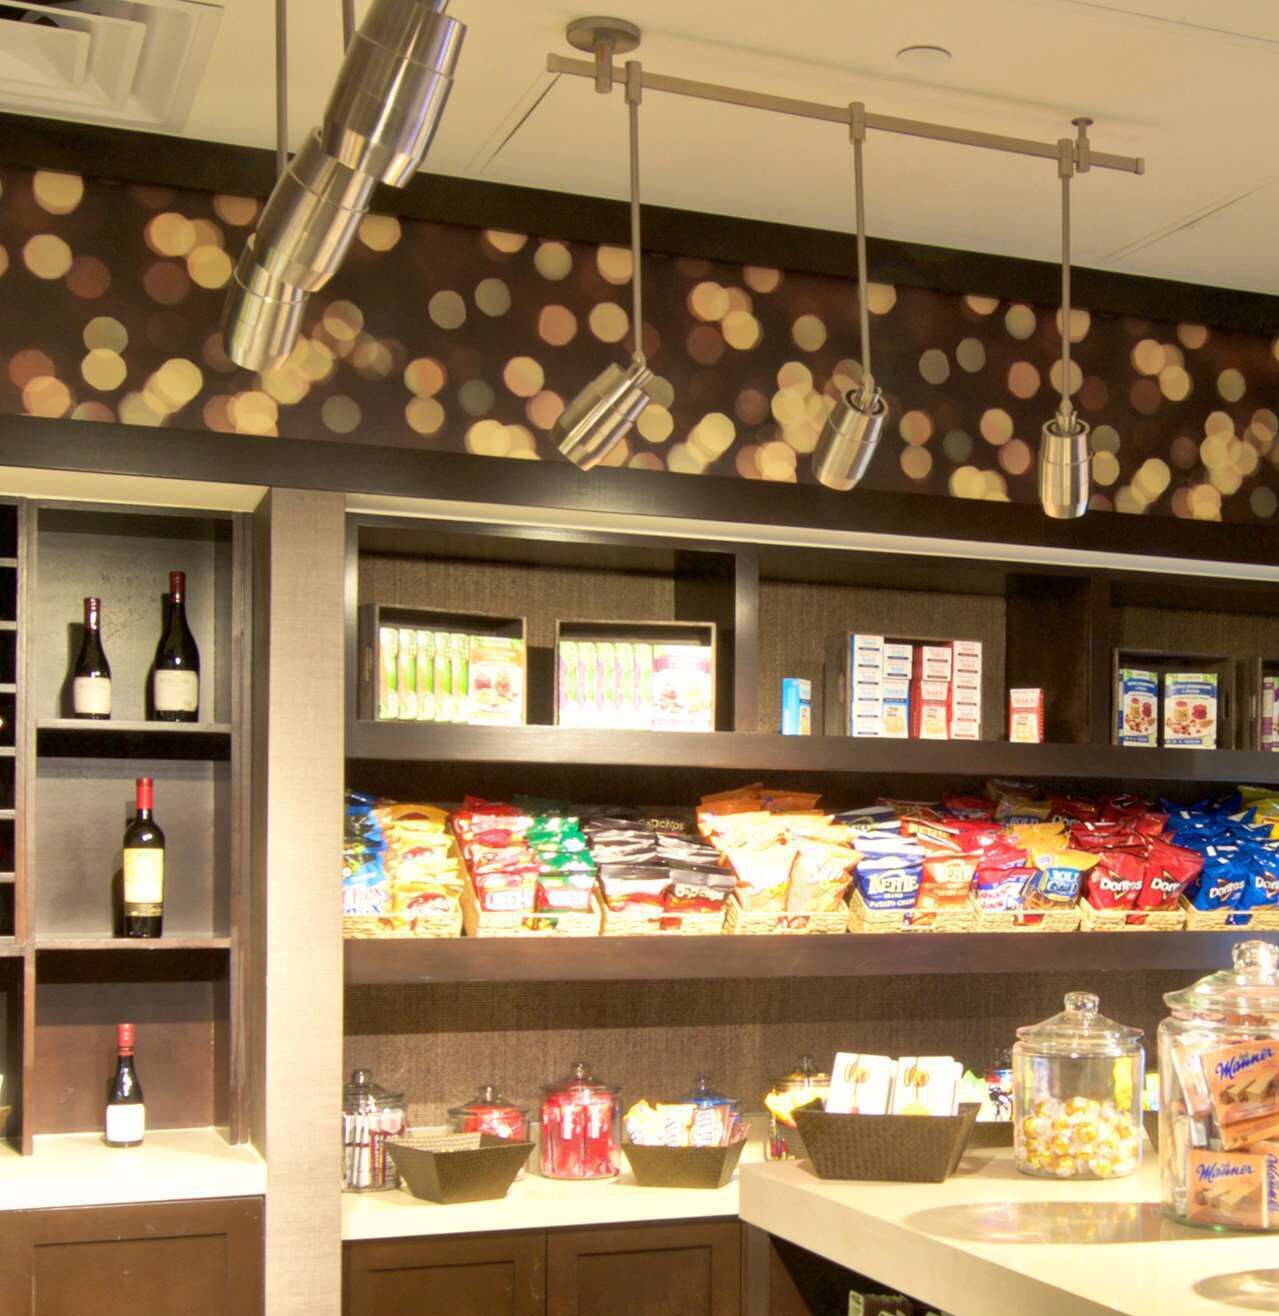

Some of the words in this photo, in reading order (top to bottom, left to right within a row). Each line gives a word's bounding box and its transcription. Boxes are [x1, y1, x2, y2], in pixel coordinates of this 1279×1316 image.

[1100, 879, 1142, 892] Doritos
[1209, 880, 1245, 899] Doritos
[1216, 1048, 1274, 1081] Manner
[1196, 1162, 1254, 1183] Manner
